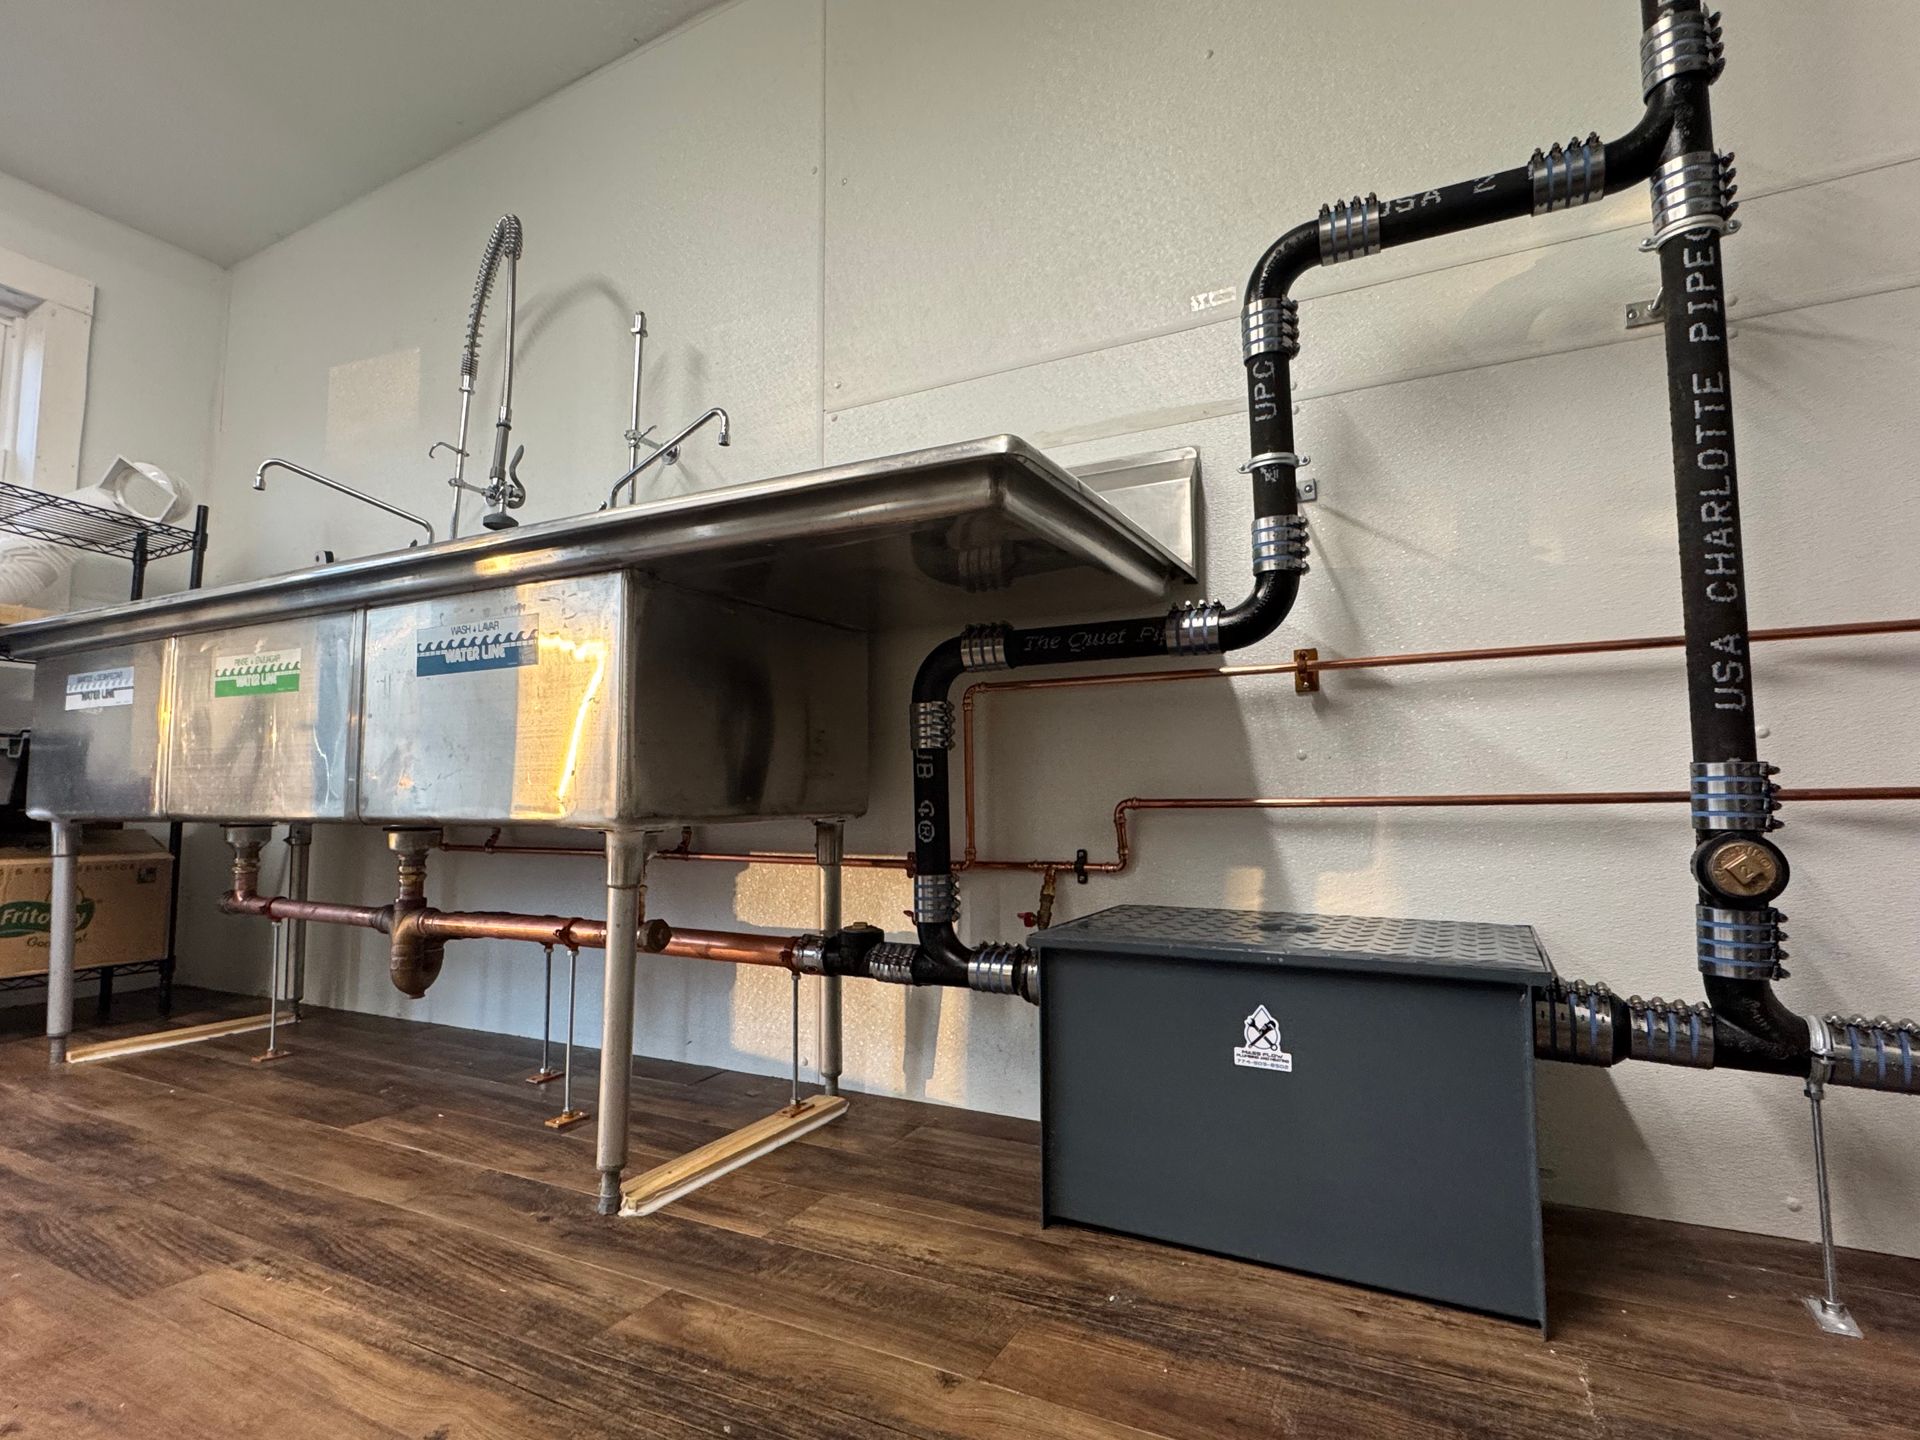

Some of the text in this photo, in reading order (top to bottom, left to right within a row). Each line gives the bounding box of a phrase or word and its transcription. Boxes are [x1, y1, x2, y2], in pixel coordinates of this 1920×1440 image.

[1692, 371, 1738, 603] CHARLOTTE
[450, 624, 472, 636] WASH
[1024, 634, 1062, 651] The
[1068, 629, 1126, 653] Quiet
[445, 643, 506, 664] WATER LINE
[1710, 633, 1746, 711] USA
